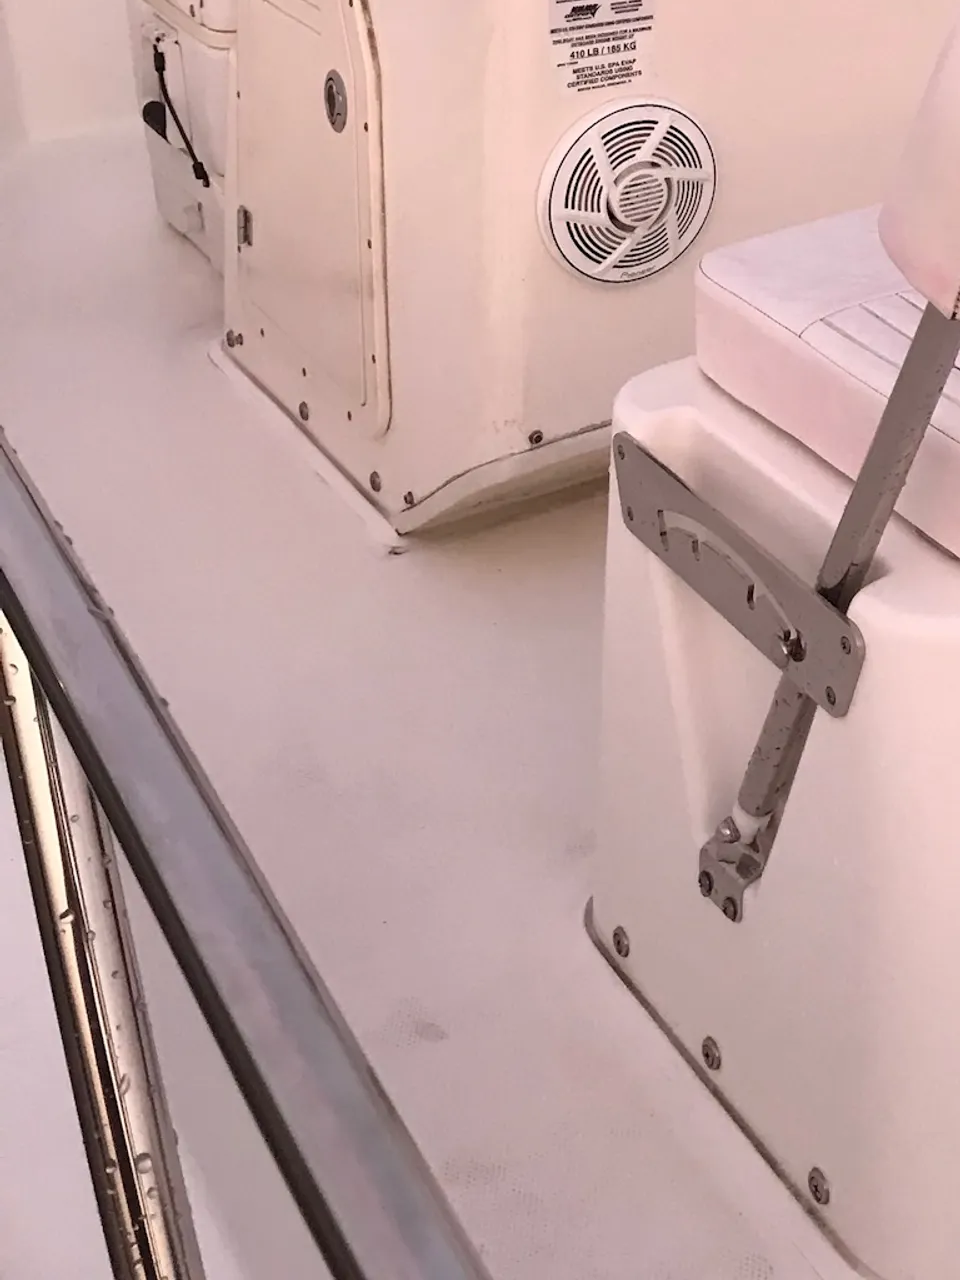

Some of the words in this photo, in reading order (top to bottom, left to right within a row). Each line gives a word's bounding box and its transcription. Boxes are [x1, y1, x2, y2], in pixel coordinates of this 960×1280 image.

[569, 49, 586, 60] 410
[587, 47, 600, 57] LB
[622, 41, 637, 51] KG
[572, 66, 594, 74] MEETS
[576, 69, 614, 80] STANDARDS
[566, 77, 600, 89] CERTIFIED
[600, 70, 643, 83] COMPONENTS
